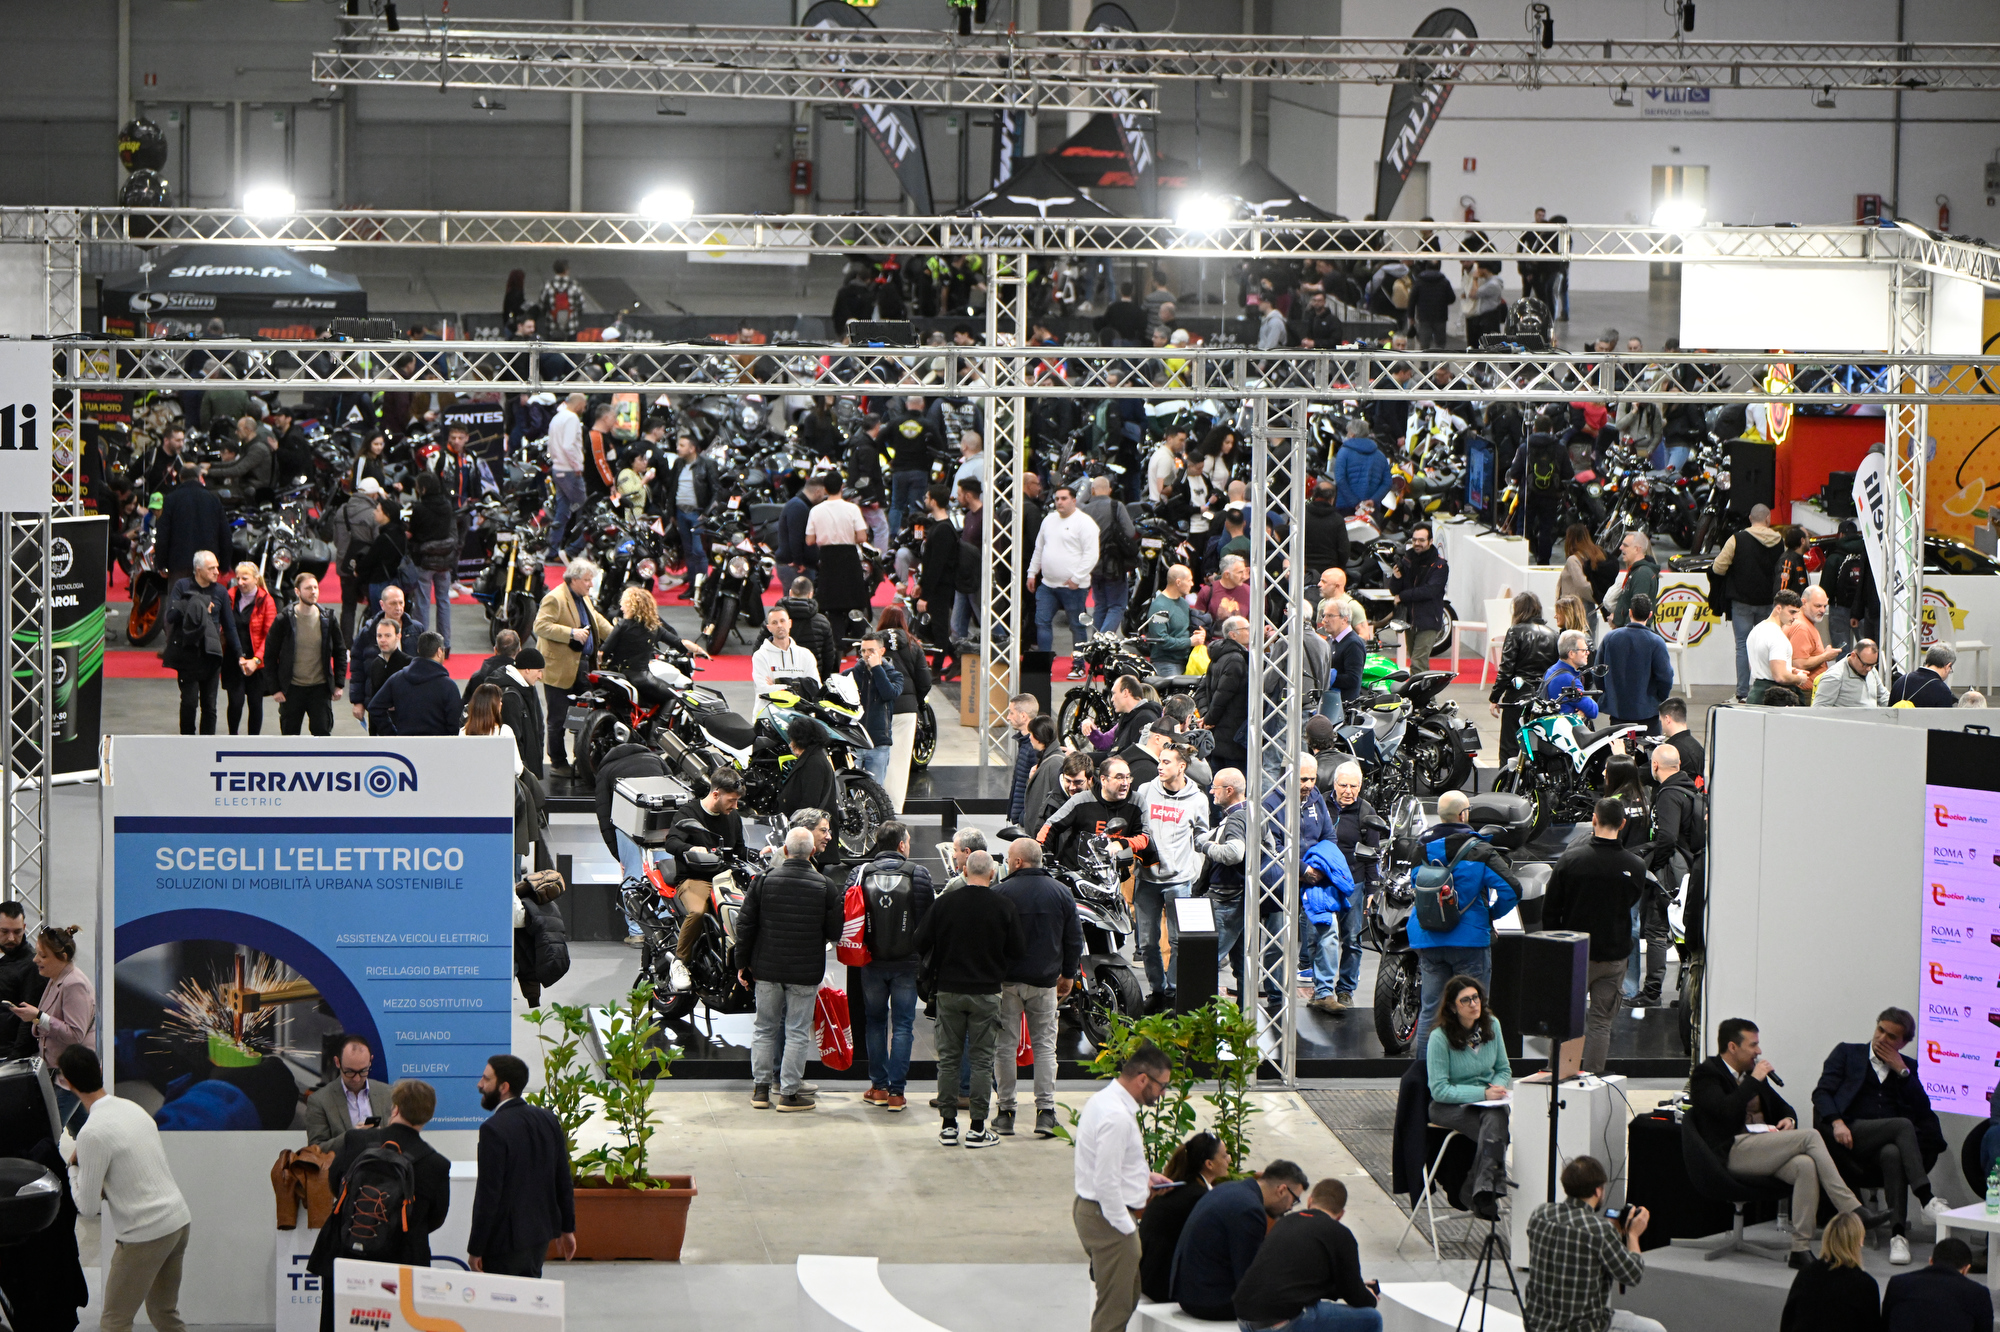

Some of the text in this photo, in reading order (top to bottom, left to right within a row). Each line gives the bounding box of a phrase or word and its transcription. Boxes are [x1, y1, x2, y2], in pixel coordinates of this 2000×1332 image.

[169, 264, 292, 278] sifam.fr
[444, 411, 503, 426] ZONTES
[210, 768, 418, 796] TERRAVISION
[214, 798, 282, 806] ELECTRIC
[1968, 815, 1988, 823] Arena
[1933, 846, 1963, 859] ROMA
[155, 847, 464, 871] SCEGLI L'ELETTRICO
[156, 876, 464, 890] SOLUZIONI DI MOBILITÀ URBANA SOSTENIBILE
[1965, 894, 1985, 903] Arena
[1931, 925, 1961, 938] ROMA
[336, 933, 489, 943] ASSISTENZA VEICOLI ELETTRICI
[366, 966, 480, 976] RICELLAGGIO BATTERIE
[1963, 973, 1983, 982] Arena
[383, 998, 483, 1008] MEZZO SOSTITUTIVO
[1928, 1003, 1959, 1017] ROMA
[395, 1031, 451, 1041] TAGLIANDO
[1960, 1052, 1981, 1061] Arena
[402, 1064, 450, 1073] DELIVERY
[1926, 1082, 1956, 1095] ROMA
